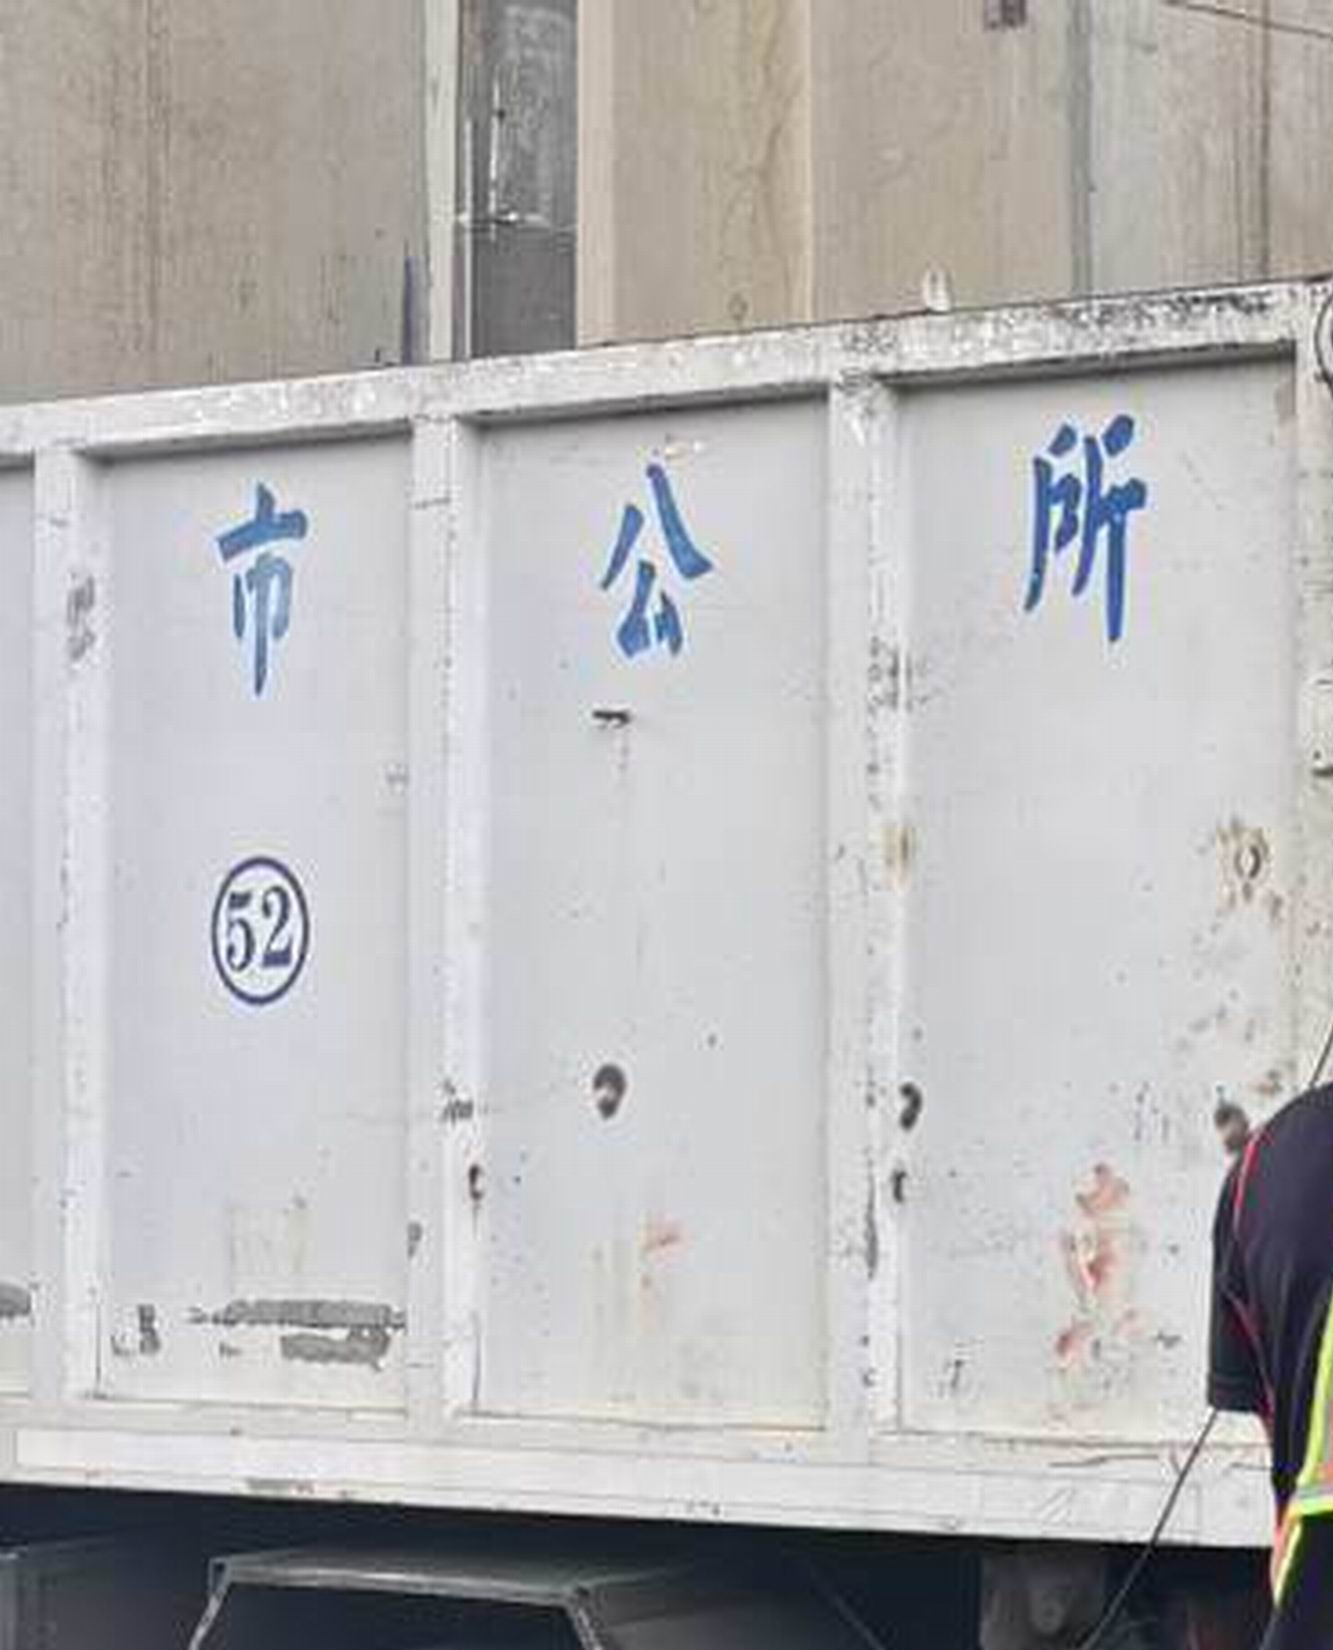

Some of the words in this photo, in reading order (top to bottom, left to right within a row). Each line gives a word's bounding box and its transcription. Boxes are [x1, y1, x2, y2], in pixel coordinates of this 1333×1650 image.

[212, 411, 1148, 696] 市公所
[225, 885, 294, 973] 52
